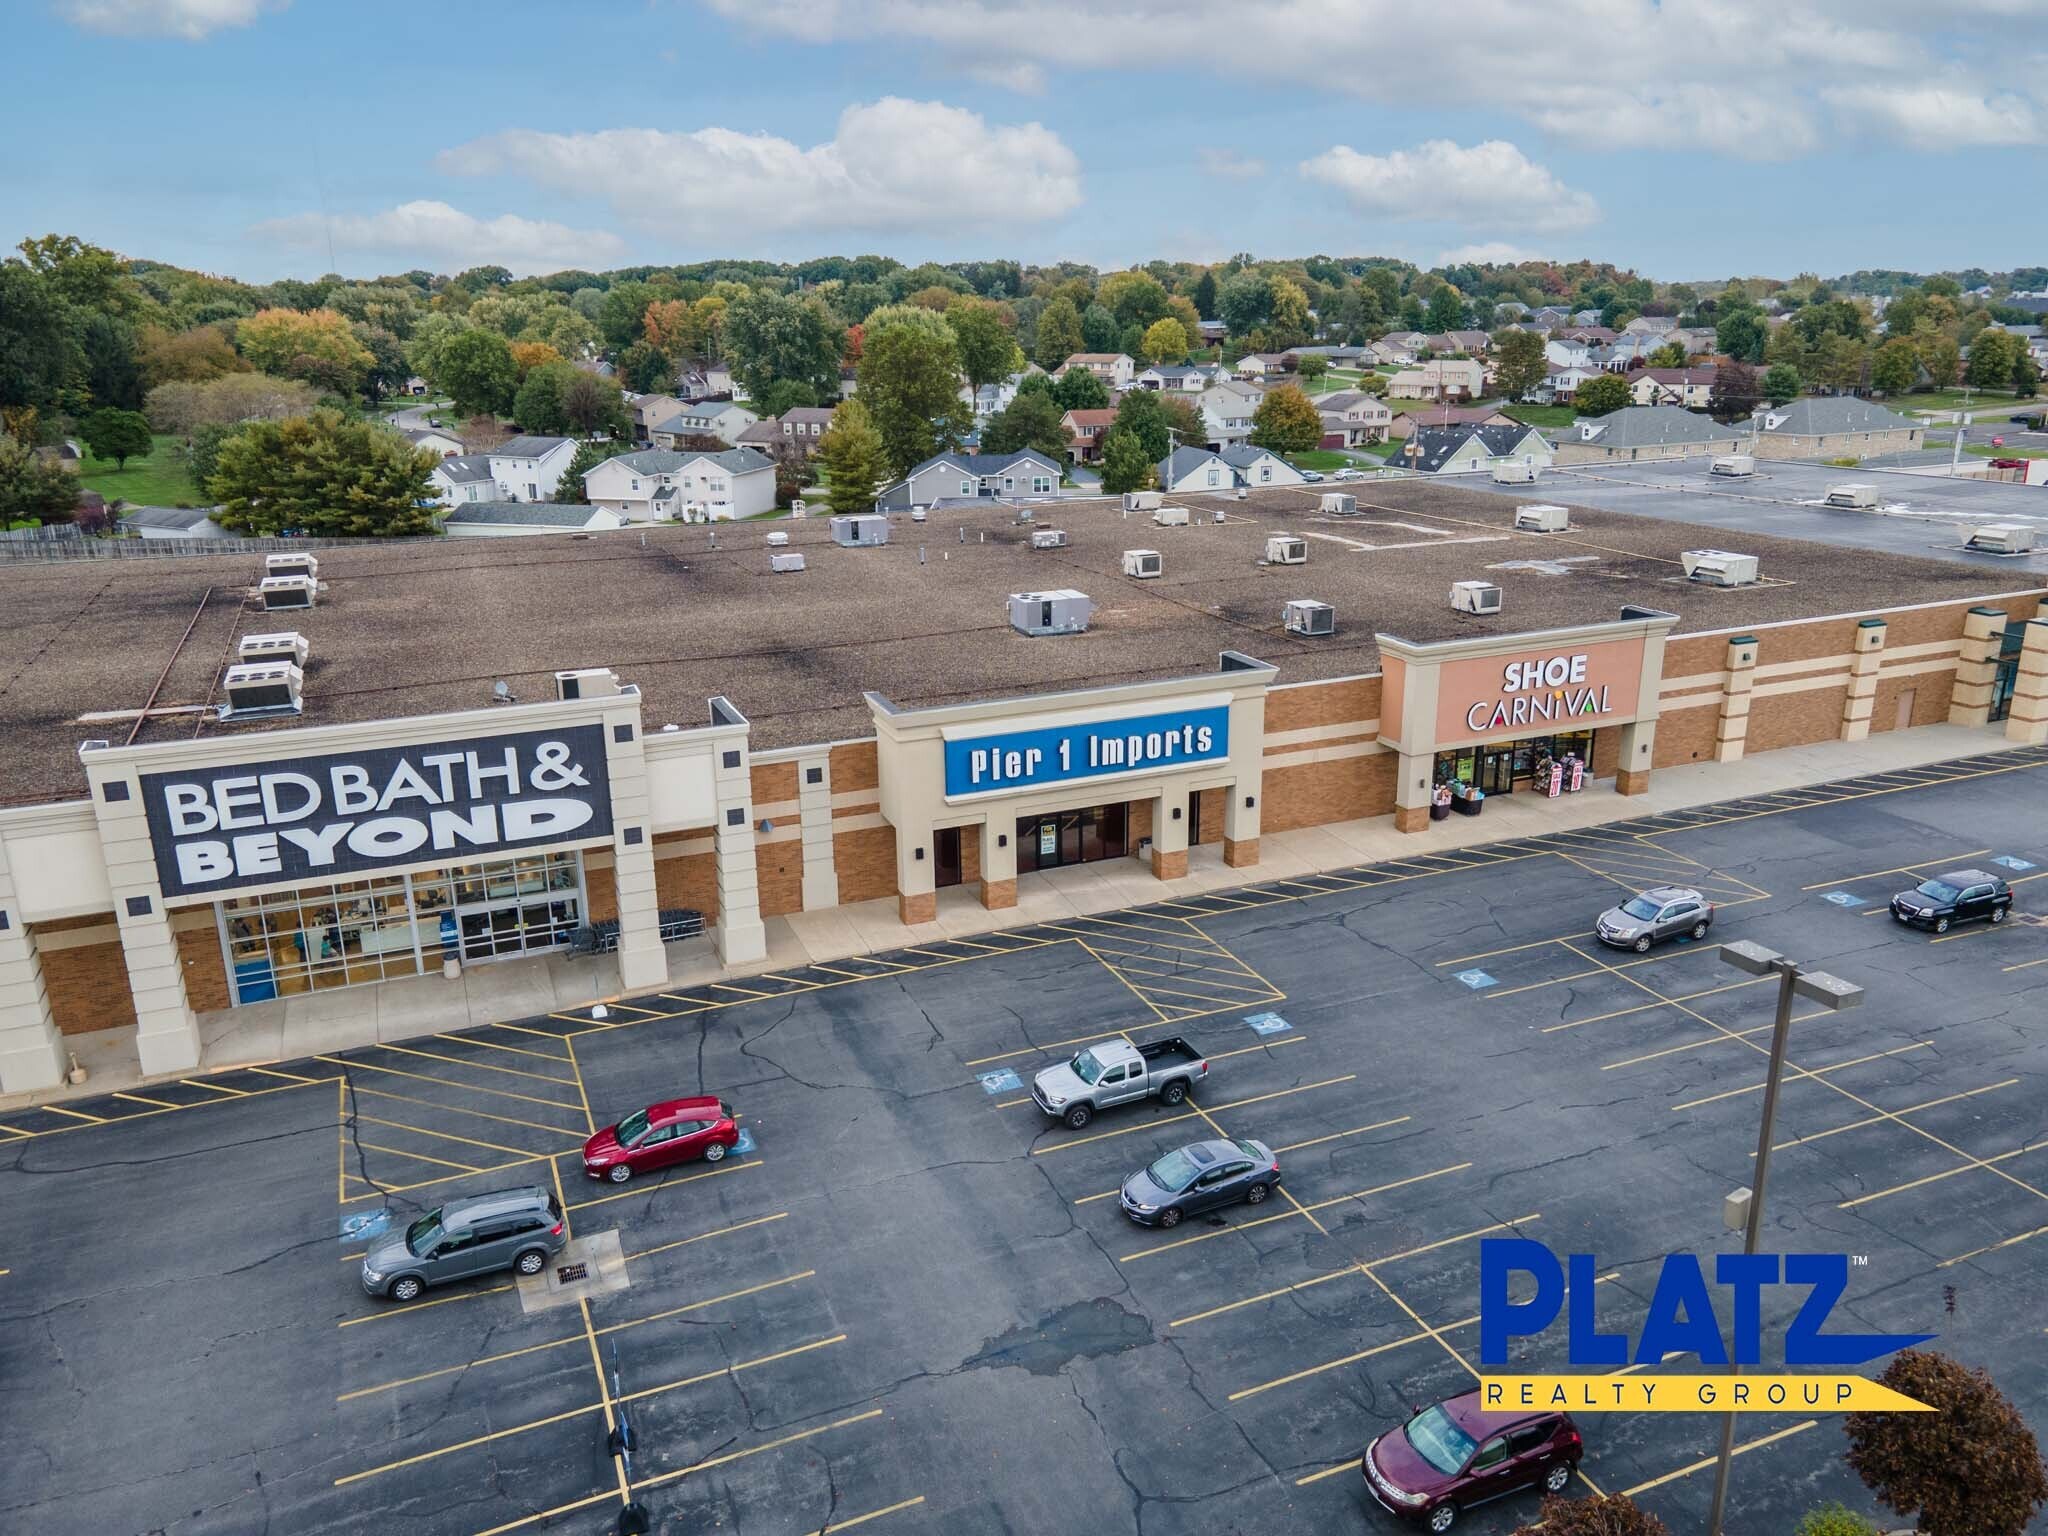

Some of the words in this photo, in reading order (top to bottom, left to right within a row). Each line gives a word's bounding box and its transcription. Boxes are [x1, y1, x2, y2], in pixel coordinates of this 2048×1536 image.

[1503, 654, 1588, 693] SHOE
[1467, 685, 1613, 731] CARNIVAL
[972, 748, 1042, 784] Pier
[1060, 739, 1070, 771] 1
[1090, 725, 1212, 767] Imports
[165, 773, 321, 836] BED
[331, 742, 520, 815] BATH
[530, 741, 591, 791] &
[176, 798, 594, 885] BEYOND
